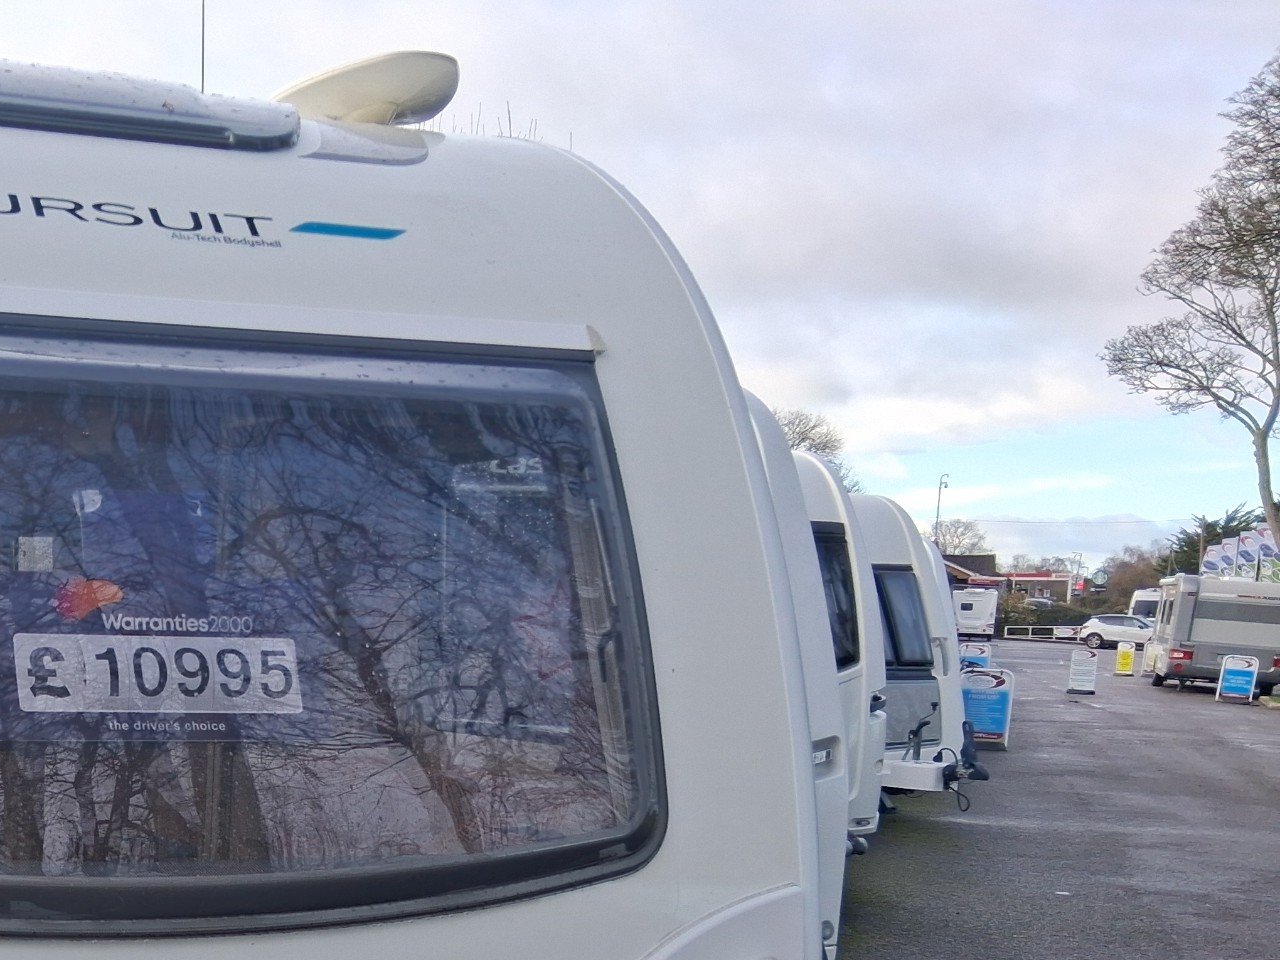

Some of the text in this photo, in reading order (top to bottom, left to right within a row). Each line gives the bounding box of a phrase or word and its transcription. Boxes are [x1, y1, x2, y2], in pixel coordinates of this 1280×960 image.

[171, 231, 282, 248] Alu-Tech Bodyshell
[27, 646, 294, 700] £ 10995
[109, 719, 226, 731] the driver's choice
